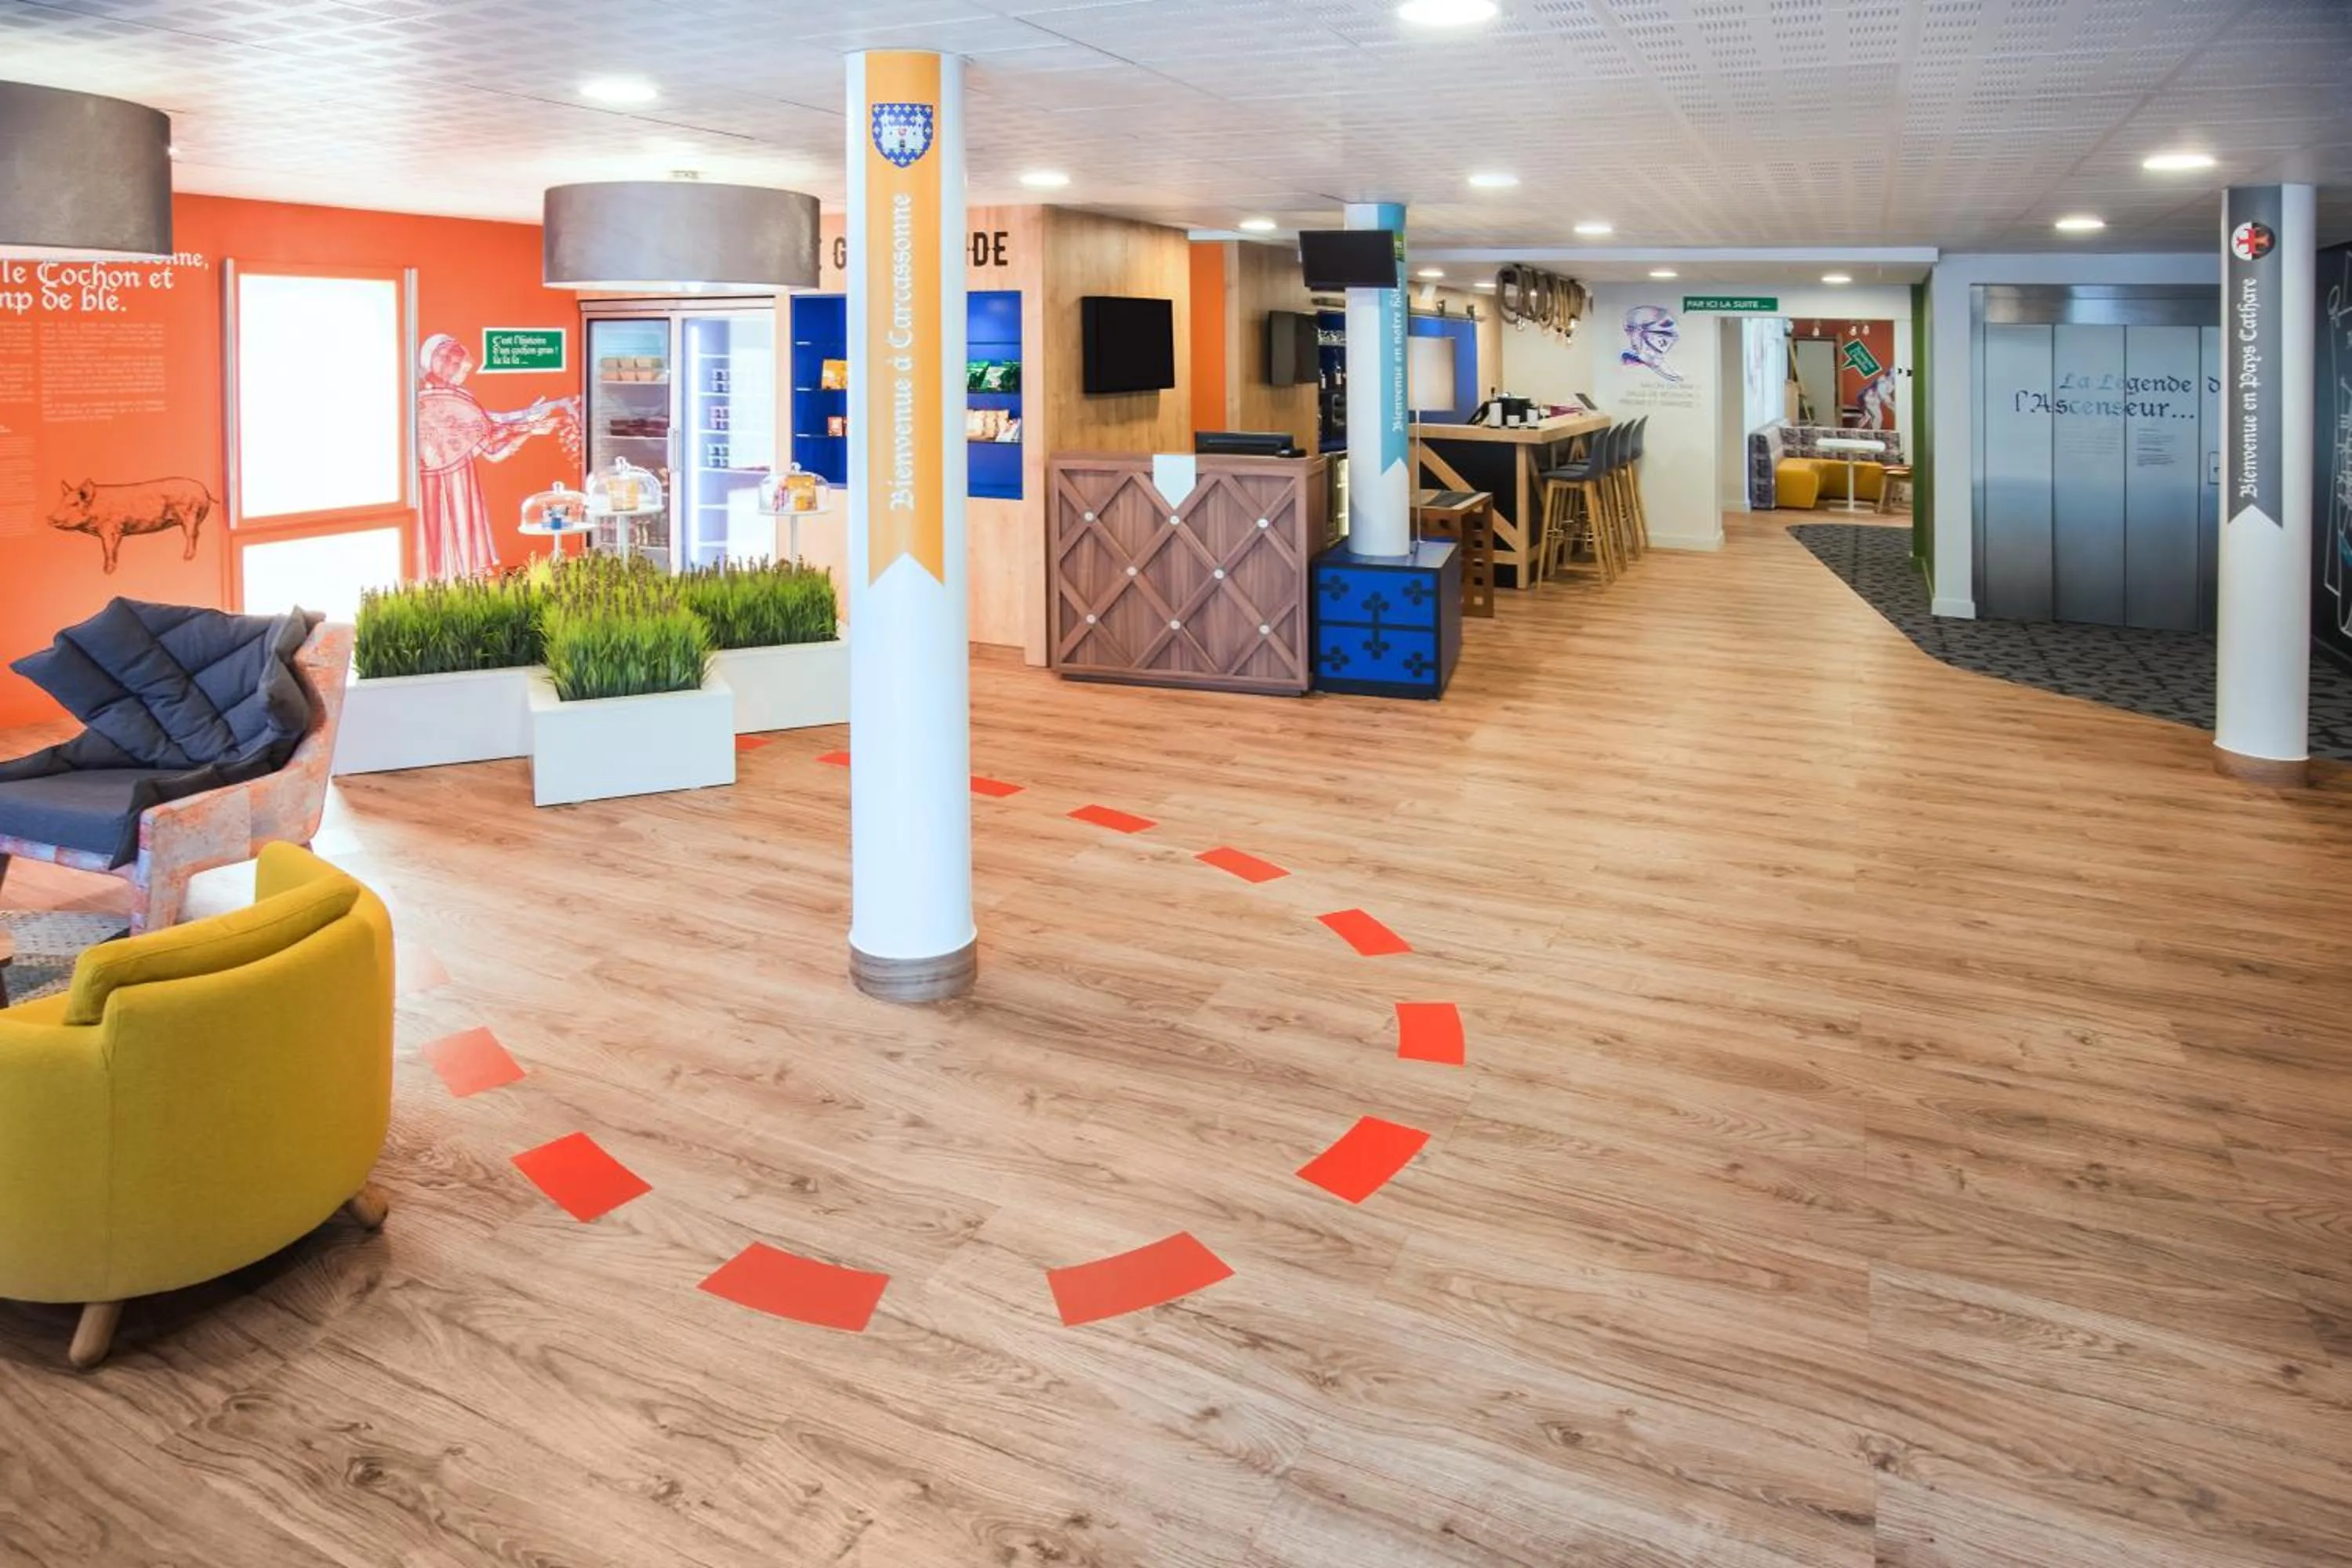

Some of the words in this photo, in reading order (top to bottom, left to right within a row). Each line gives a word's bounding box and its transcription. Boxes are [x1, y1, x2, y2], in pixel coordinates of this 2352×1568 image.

[3, 260, 26, 283] le
[37, 259, 141, 289] Cochon
[149, 267, 174, 289] et
[886, 192, 913, 349] Carcassonne
[42, 285, 72, 311] de
[81, 285, 127, 312] blé.
[1733, 300, 1759, 309] SUITE
[2236, 278, 2261, 341] Cathare
[2207, 376, 2221, 394] d
[2238, 345, 2262, 388] Pays
[1392, 365, 1403, 433] Bienvenue
[2242, 392, 2258, 411] en
[889, 379, 914, 511] Bienvenue
[2238, 414, 2258, 498] Bienvenue
